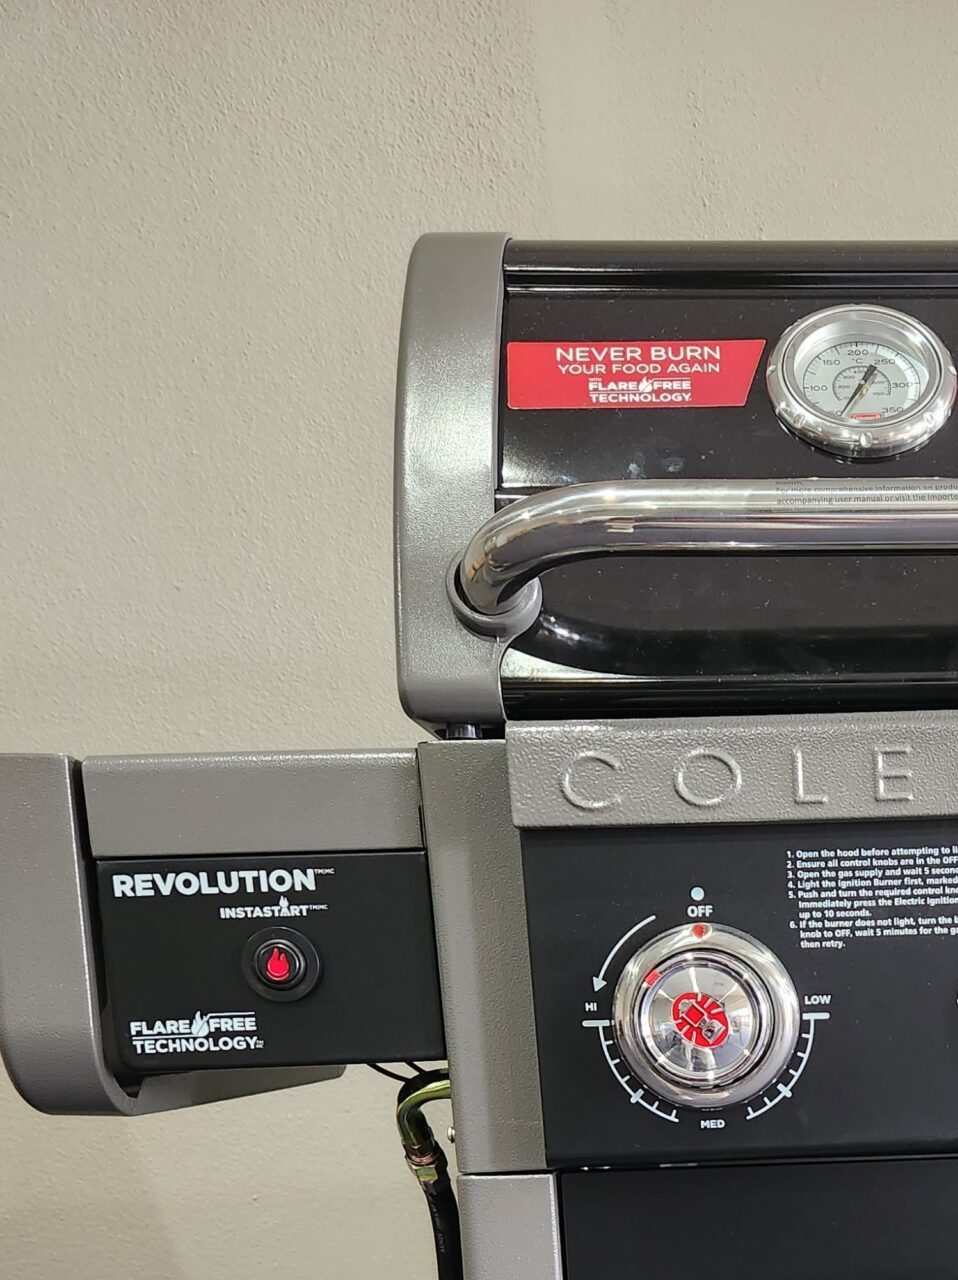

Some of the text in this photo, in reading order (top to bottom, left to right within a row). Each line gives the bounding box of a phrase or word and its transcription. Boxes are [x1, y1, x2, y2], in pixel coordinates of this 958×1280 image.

[556, 346, 721, 362] NEVER BURN
[558, 362, 720, 375] YOUR FOOD AGAIN
[874, 358, 896, 366] 250
[588, 380, 691, 391] FLARE FREE
[590, 391, 692, 403] TECHNOLOGY
[882, 406, 904, 414] 350
[777, 495, 833, 505] accompanying
[835, 495, 851, 503] user
[854, 494, 882, 502] manual
[895, 493, 910, 501] visit
[912, 493, 926, 501] the
[786, 850, 794, 858] 1.
[796, 849, 819, 860] Open
[820, 848, 835, 857] the
[837, 848, 859, 856] hood
[861, 847, 889, 856] before
[891, 846, 939, 857] attempting
[941, 846, 950, 854] to
[786, 860, 794, 868] 2.
[796, 859, 825, 868] Ensure
[827, 858, 838, 867] all
[840, 857, 871, 866] control
[872, 856, 898, 865] knobs
[916, 856, 925, 864] in
[926, 855, 940, 864] the
[942, 855, 958, 863] OFF
[786, 870, 795, 878] 3.
[797, 869, 820, 880] Open
[821, 868, 836, 877] the
[838, 870, 853, 879] gas
[855, 867, 882, 878] supply
[884, 866, 901, 875] and
[903, 866, 922, 875] wait
[924, 866, 930, 874] 5
[112, 868, 317, 897] REVOLUTION
[787, 875, 958, 890] 4. Light the Burner first, marked
[788, 890, 796, 898] 5.
[798, 889, 818, 898] Push
[820, 888, 837, 897] and
[838, 888, 857, 897] turn
[858, 887, 873, 896] the
[875, 886, 911, 897] required
[913, 885, 942, 894] control
[853, 900, 876, 909] press
[878, 897, 892, 906] the
[894, 896, 925, 905] Electric
[220, 902, 308, 919] INSTASTART
[687, 905, 713, 917] OFF
[799, 912, 811, 920] up
[812, 910, 822, 918] to
[836, 908, 872, 917] seconds.
[799, 920, 807, 928] If
[808, 919, 822, 928] the
[824, 918, 853, 927] burner
[855, 918, 875, 926] does
[877, 918, 892, 926] not
[893, 916, 916, 927] light,
[918, 916, 936, 924] turn
[938, 915, 952, 924] the
[800, 929, 822, 938] knob
[823, 930, 833, 938] to
[834, 929, 853, 938] OFF,
[855, 928, 874, 936] wait
[876, 928, 881, 936] 5
[883, 927, 918, 935] minutes
[919, 926, 932, 934] for
[934, 925, 948, 934] the
[800, 939, 846, 949] then retry.
[804, 994, 831, 1006] LOW
[585, 1002, 597, 1012] HI
[130, 1016, 257, 1035] FLARE FREE
[132, 1036, 258, 1054] TECHNOLOGY
[700, 1119, 725, 1129] MED
